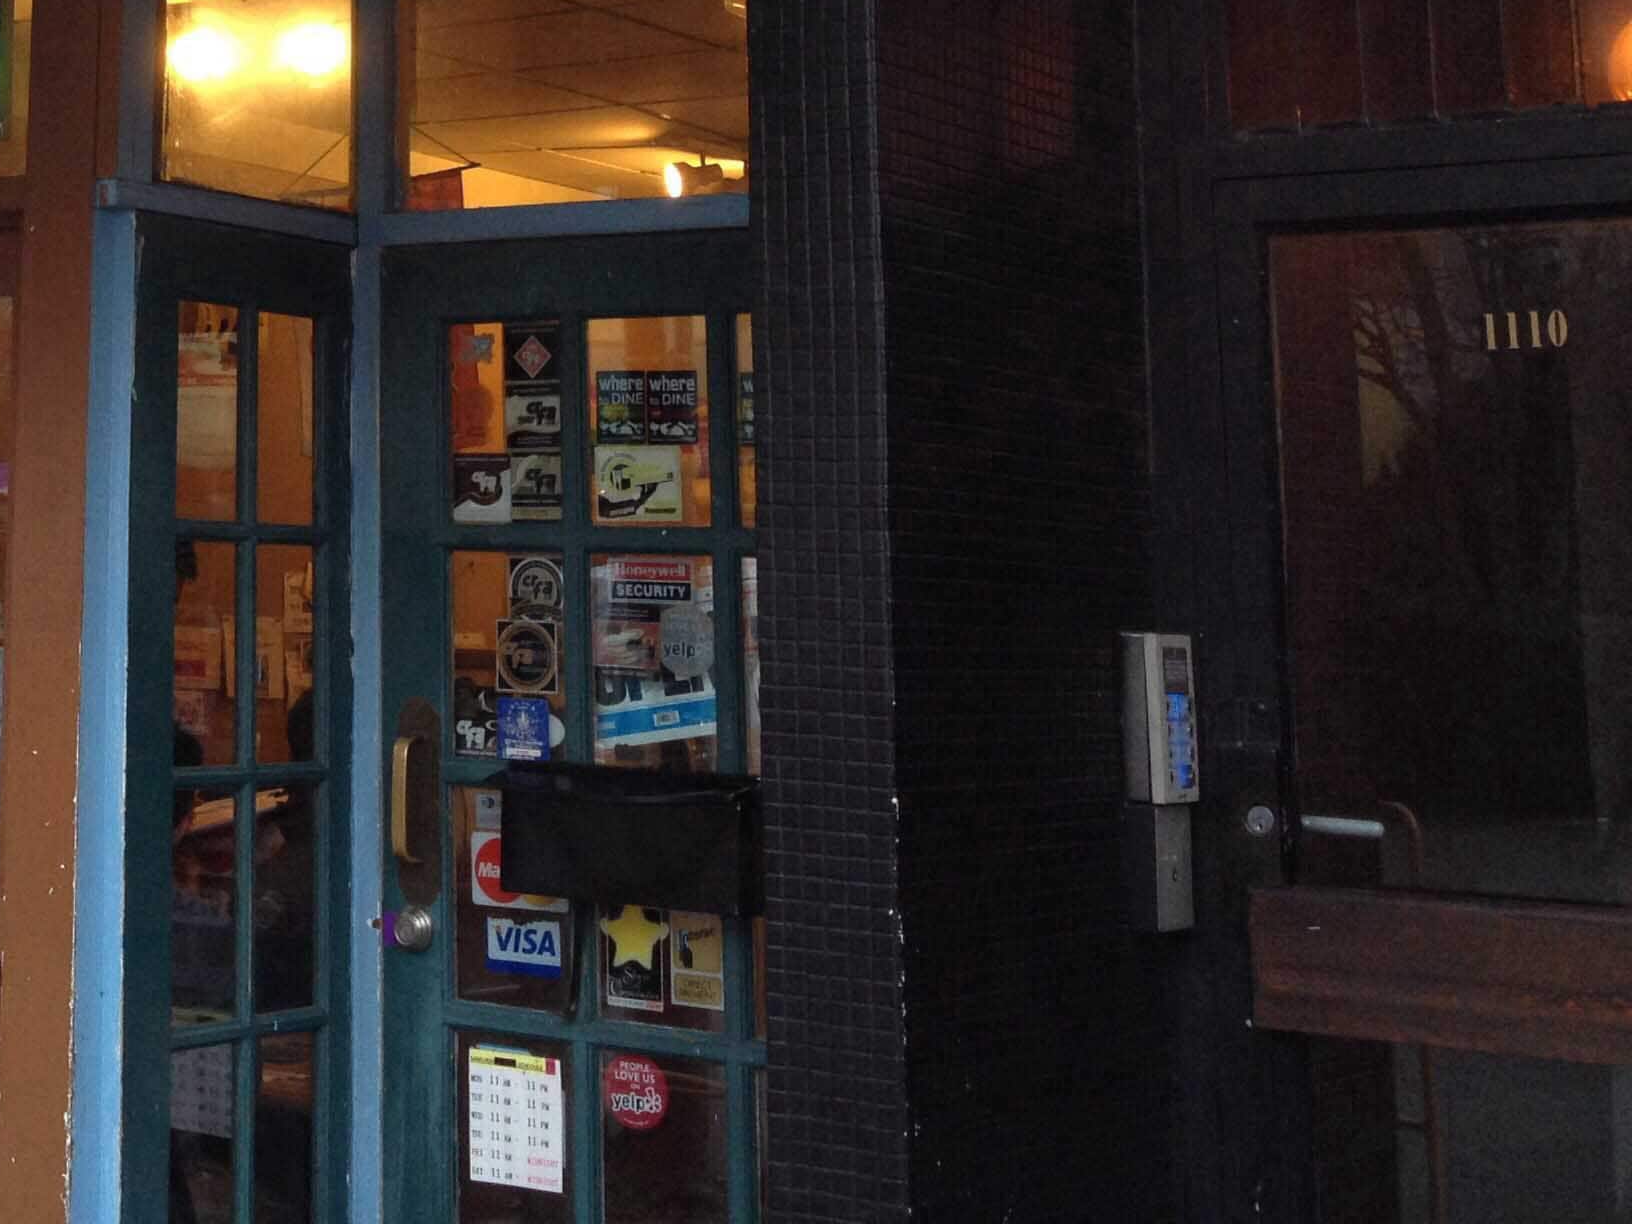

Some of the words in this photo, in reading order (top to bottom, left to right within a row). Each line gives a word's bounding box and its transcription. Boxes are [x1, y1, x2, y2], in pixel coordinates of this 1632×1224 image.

[1483, 310, 1568, 350] 1110
[599, 375, 643, 391] where
[649, 375, 696, 392] where
[611, 392, 643, 405] DINE
[662, 392, 696, 405] DINE
[616, 562, 687, 579] Honeywell
[616, 583, 686, 599] SECURITY
[664, 640, 696, 659] yelp
[495, 927, 556, 957] VISA
[614, 1070, 640, 1081] LOVE
[643, 1074, 655, 1084] US
[611, 1092, 646, 1114] yelp
